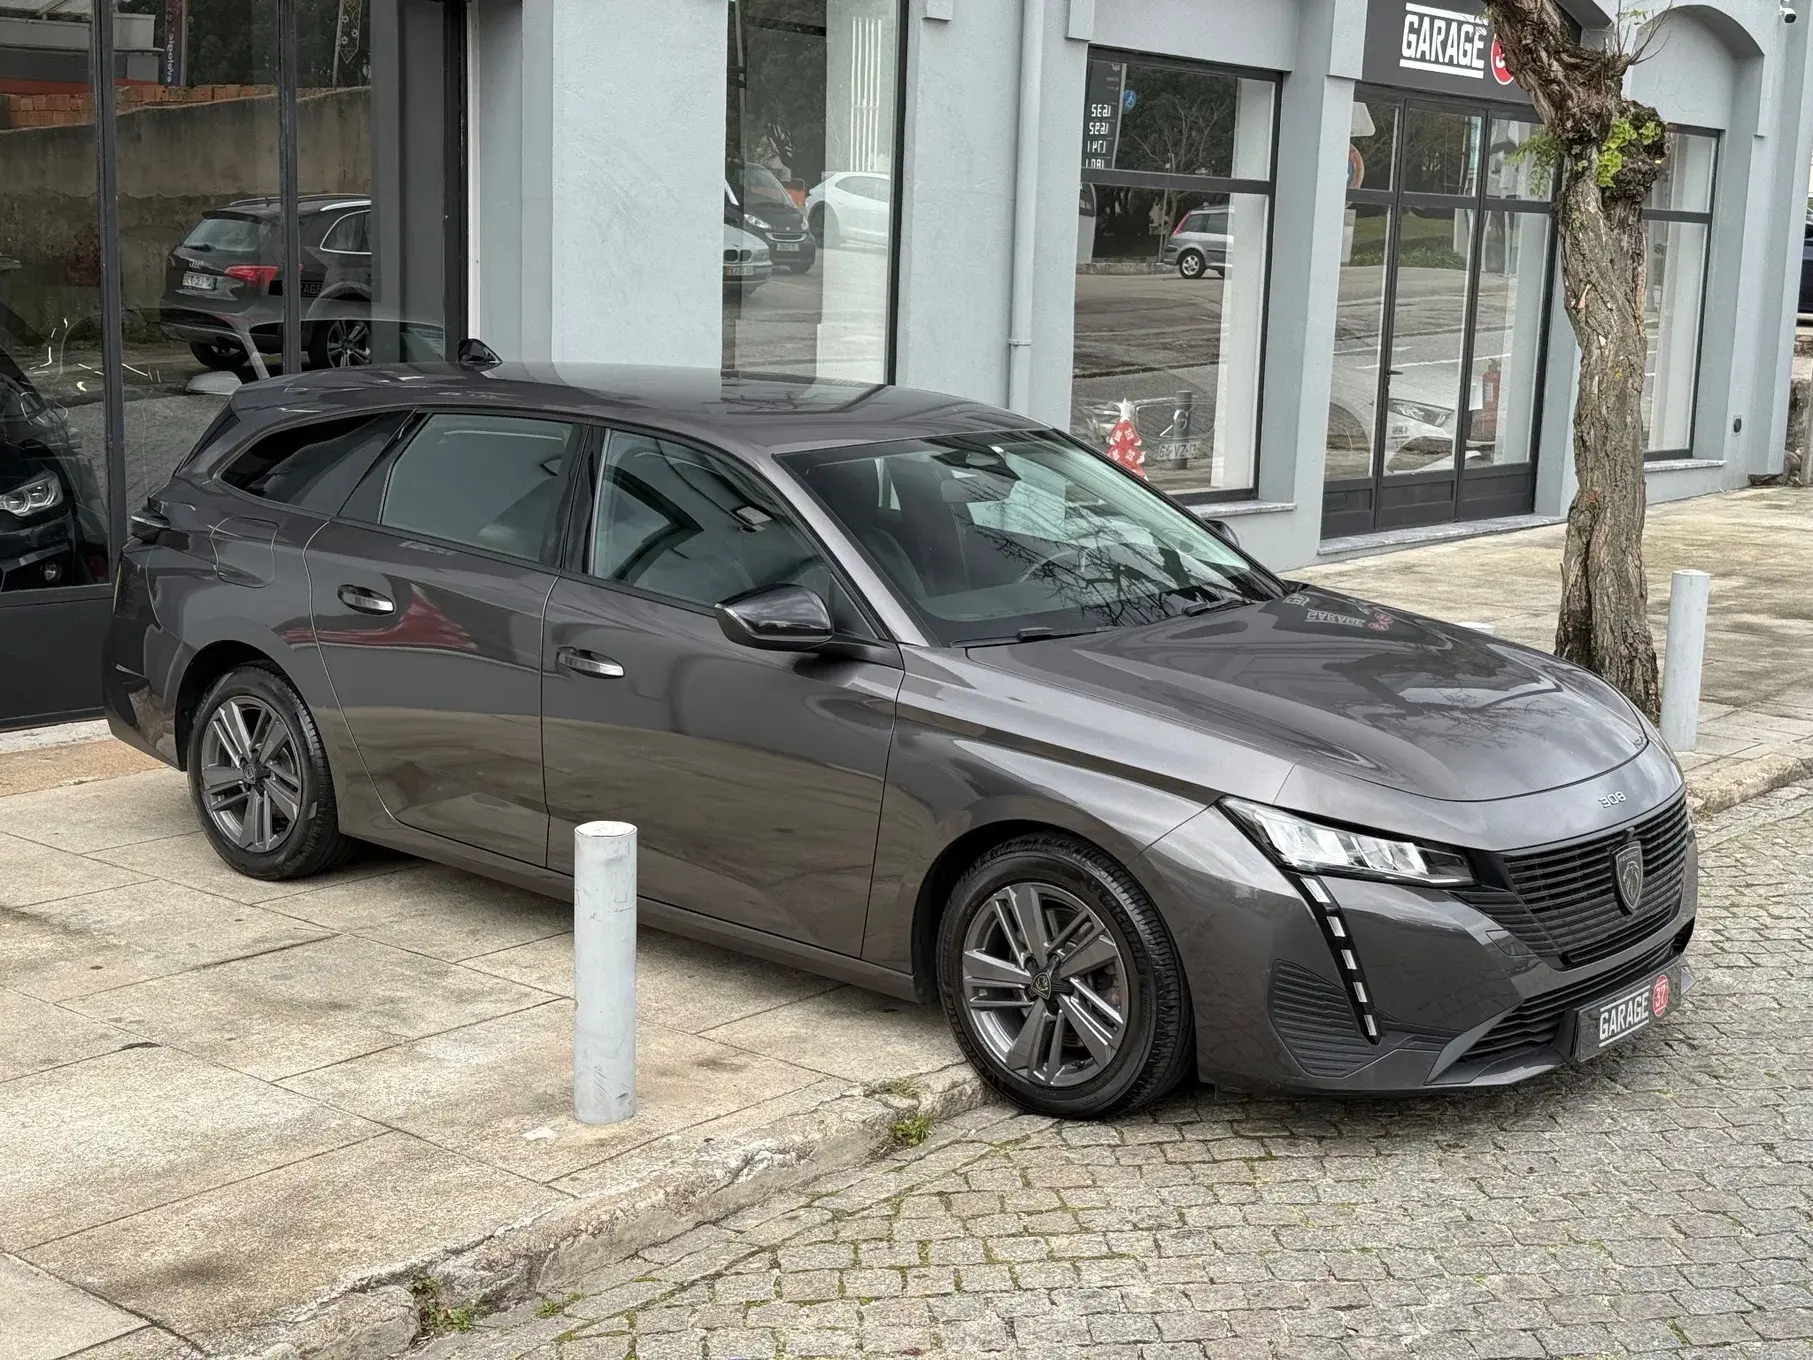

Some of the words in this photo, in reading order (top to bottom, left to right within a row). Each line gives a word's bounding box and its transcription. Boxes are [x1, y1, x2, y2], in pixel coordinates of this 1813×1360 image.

[1401, 13, 1486, 69] GARAGE
[1599, 791, 1627, 808] 308
[1599, 991, 1650, 1040] GARAGE
[1654, 984, 1667, 1008] 37
